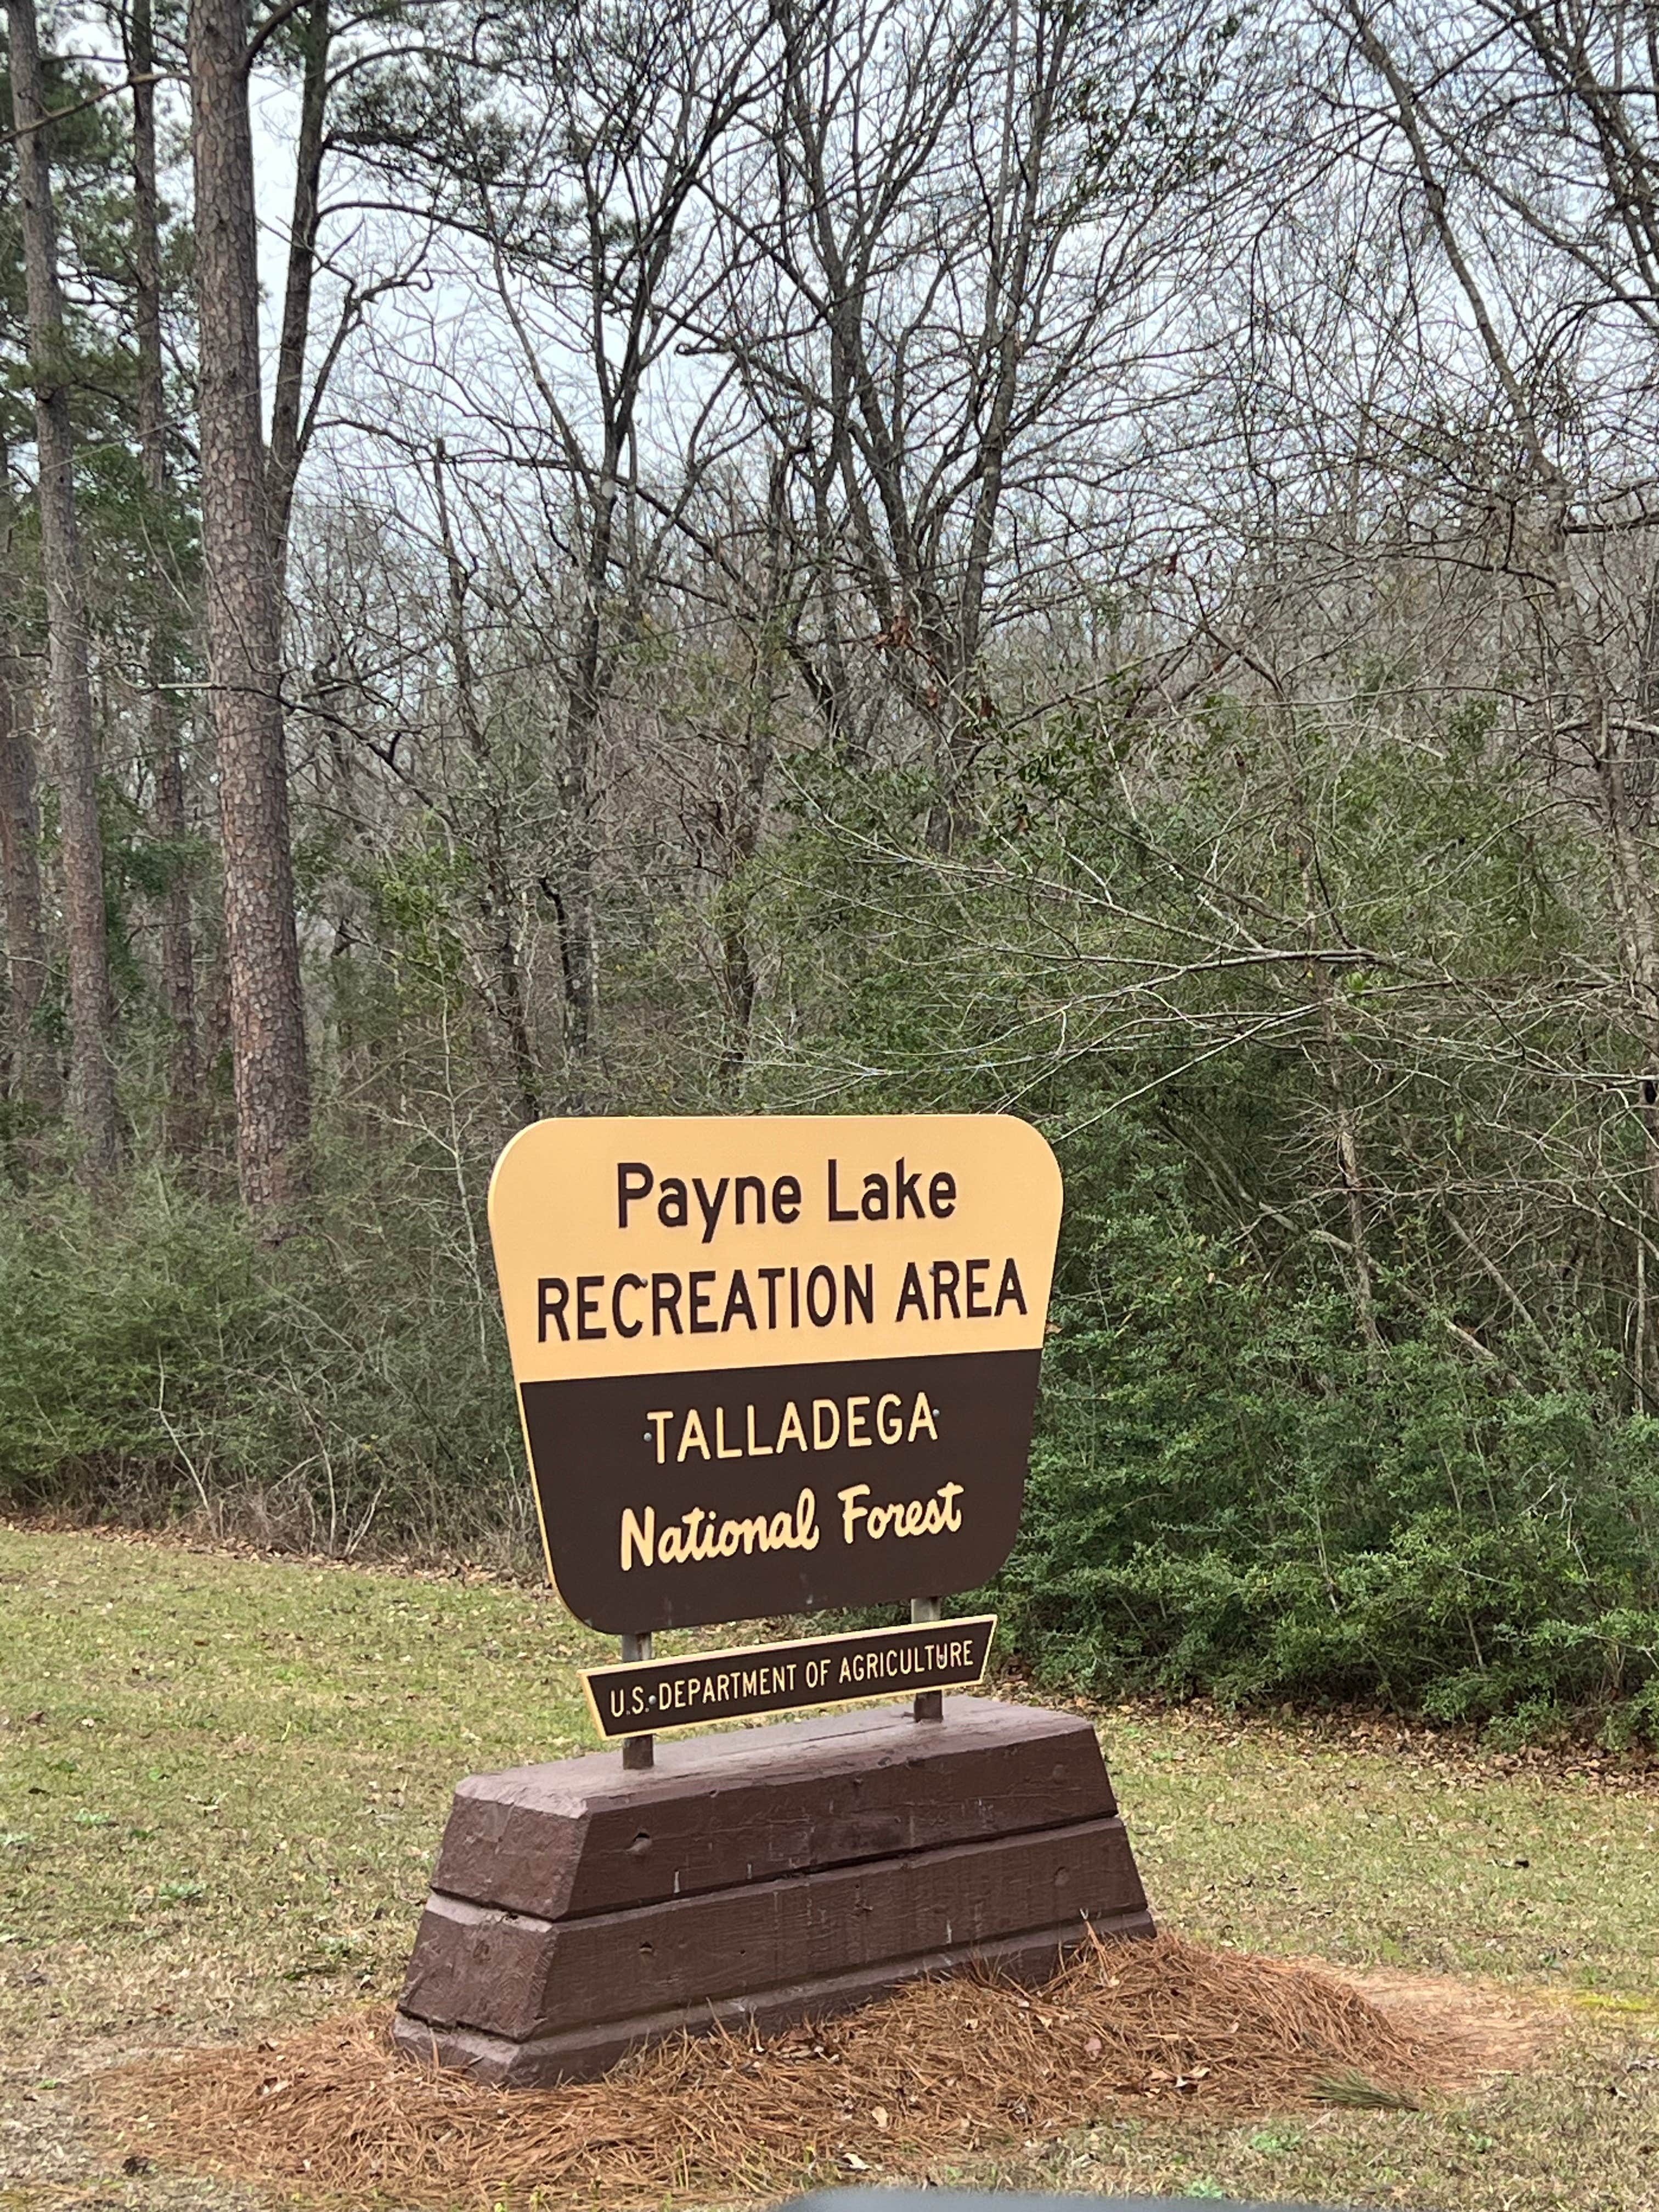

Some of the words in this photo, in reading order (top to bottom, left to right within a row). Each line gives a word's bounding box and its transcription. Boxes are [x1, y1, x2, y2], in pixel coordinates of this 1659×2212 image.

[617, 1162, 802, 1244] Payne
[827, 1156, 957, 1223] Lake
[537, 1263, 874, 1343] RECREATION
[895, 1257, 1028, 1322] AREA
[647, 1391, 938, 1464] TALLADEGA
[620, 1487, 820, 1571] National
[837, 1481, 964, 1544] Forest
[659, 1666, 796, 1711] DEPARTMENT
[805, 1658, 830, 1689] OF
[839, 1640, 974, 1683] AGRICULTURE
